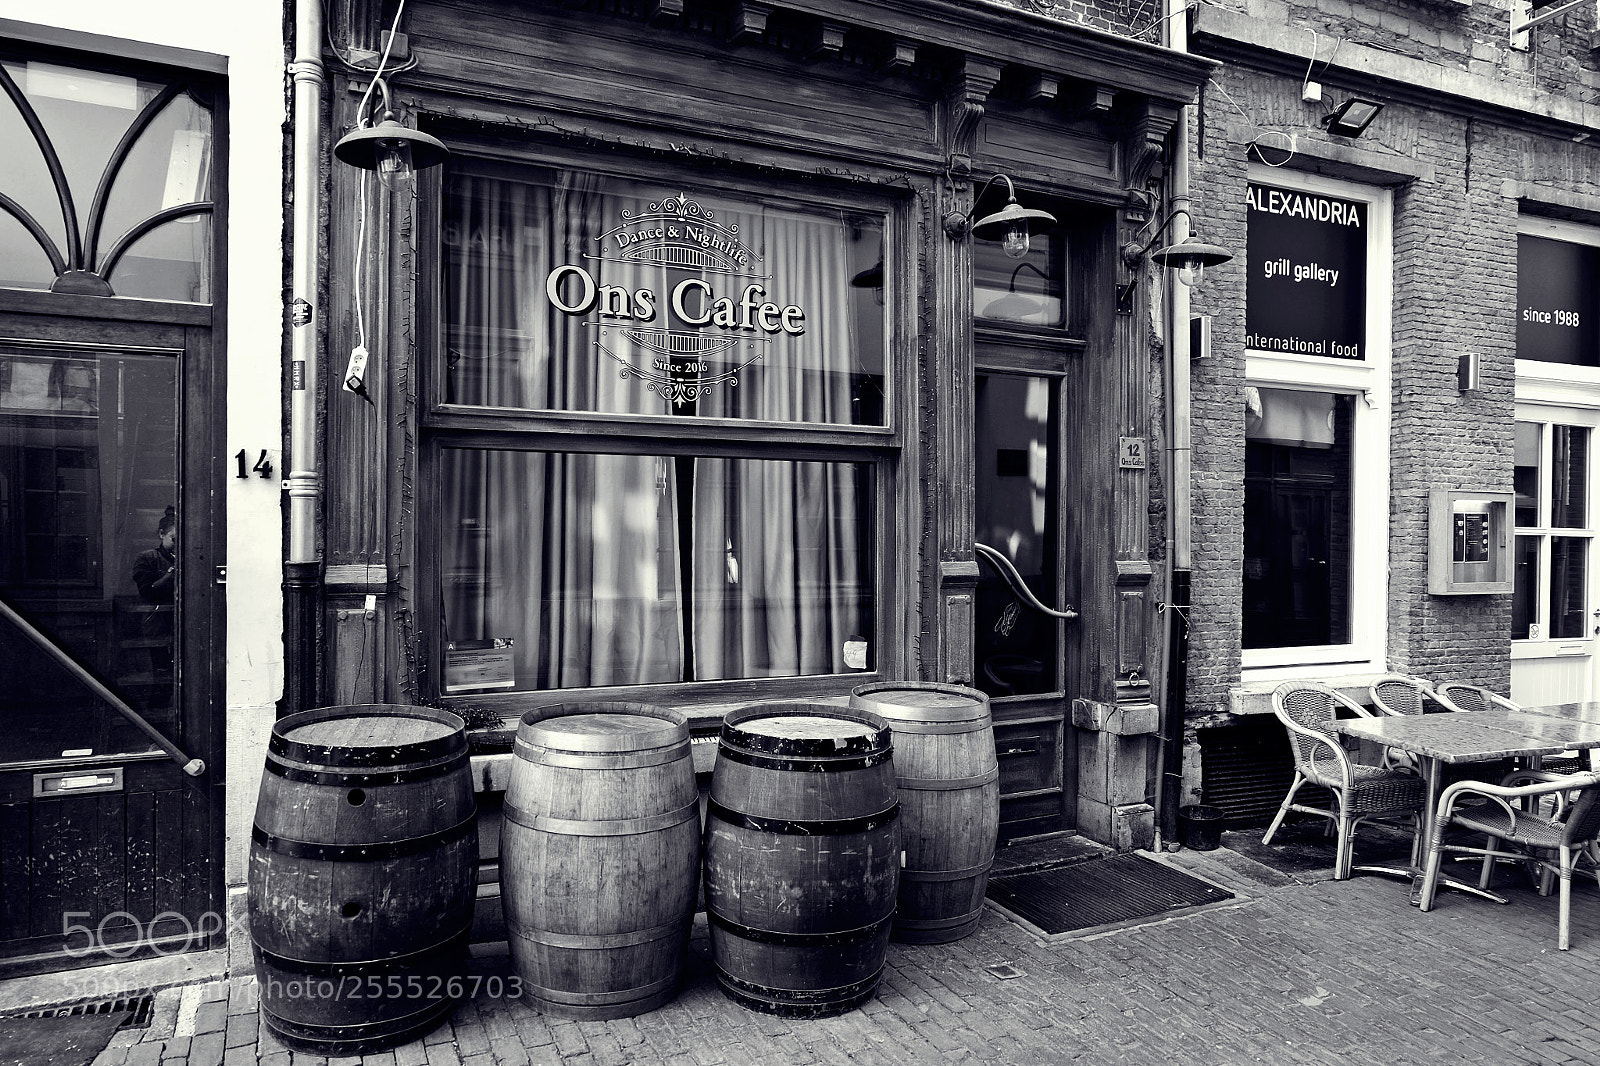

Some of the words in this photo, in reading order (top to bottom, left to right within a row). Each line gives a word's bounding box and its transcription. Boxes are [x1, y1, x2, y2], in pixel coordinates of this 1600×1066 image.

[1246, 187, 1360, 228] ALEXANDRIA
[615, 228, 663, 248] Dance
[667, 225, 680, 238] &
[684, 225, 748, 266] Nightlife
[1264, 258, 1290, 278] grill
[1294, 262, 1339, 287] gallery
[546, 264, 656, 322] Ons
[671, 278, 805, 336] Cafee
[1523, 306, 1552, 324] since
[1553, 309, 1580, 328] 1988
[1246, 333, 1326, 354] nternational
[1331, 341, 1358, 357] food
[652, 357, 682, 373] Since
[684, 361, 708, 373] 2016
[235, 448, 273, 479] 14
[1127, 443, 1141, 457] 12
